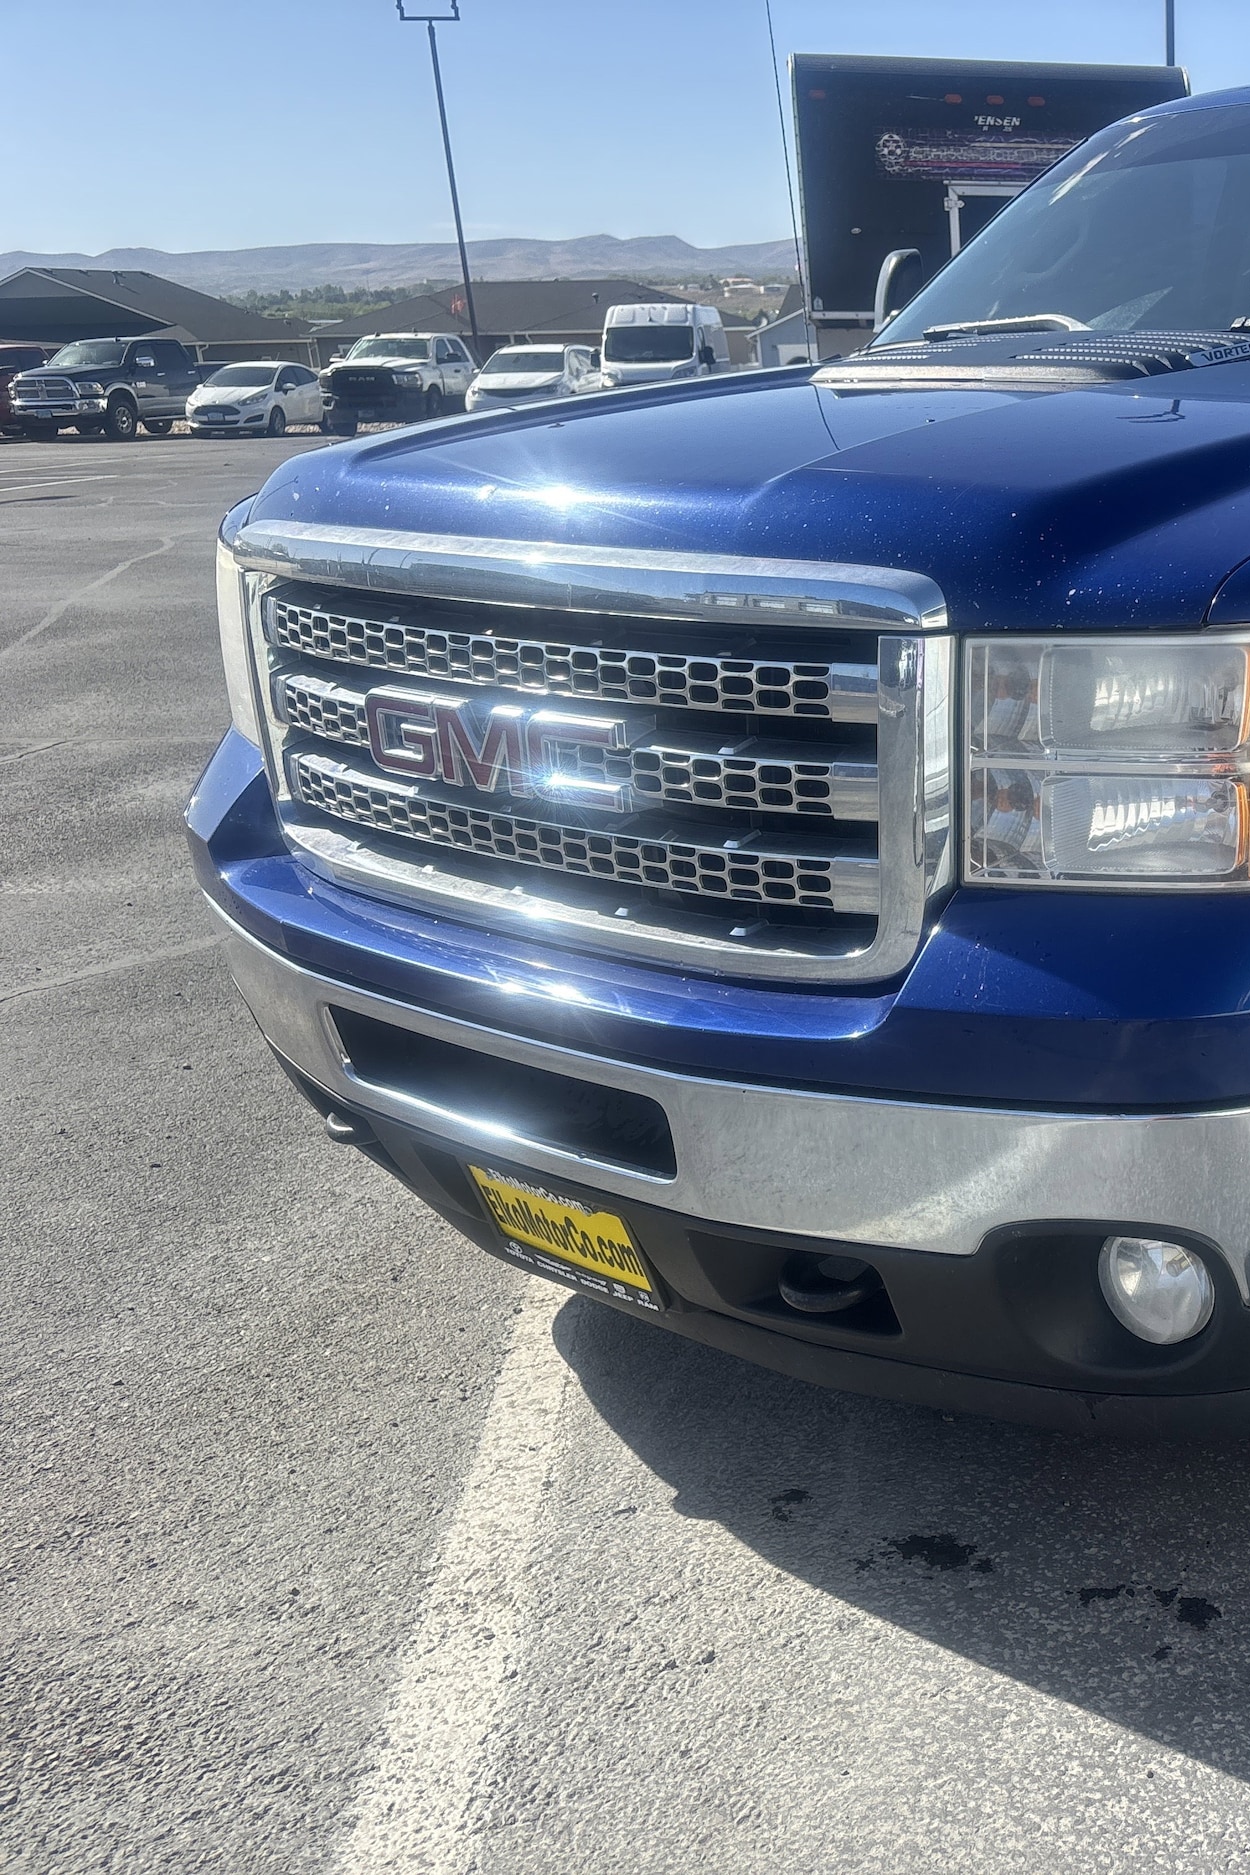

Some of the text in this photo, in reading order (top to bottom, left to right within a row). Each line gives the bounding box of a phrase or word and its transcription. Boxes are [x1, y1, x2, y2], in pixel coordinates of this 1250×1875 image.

[365, 684, 635, 813] GMC
[487, 1167, 585, 1211] ElkoMotorCo.com
[481, 1185, 645, 1277] ElkoMotorCo.com
[504, 1246, 535, 1265] TOYOTA
[637, 1298, 660, 1312] RAM
